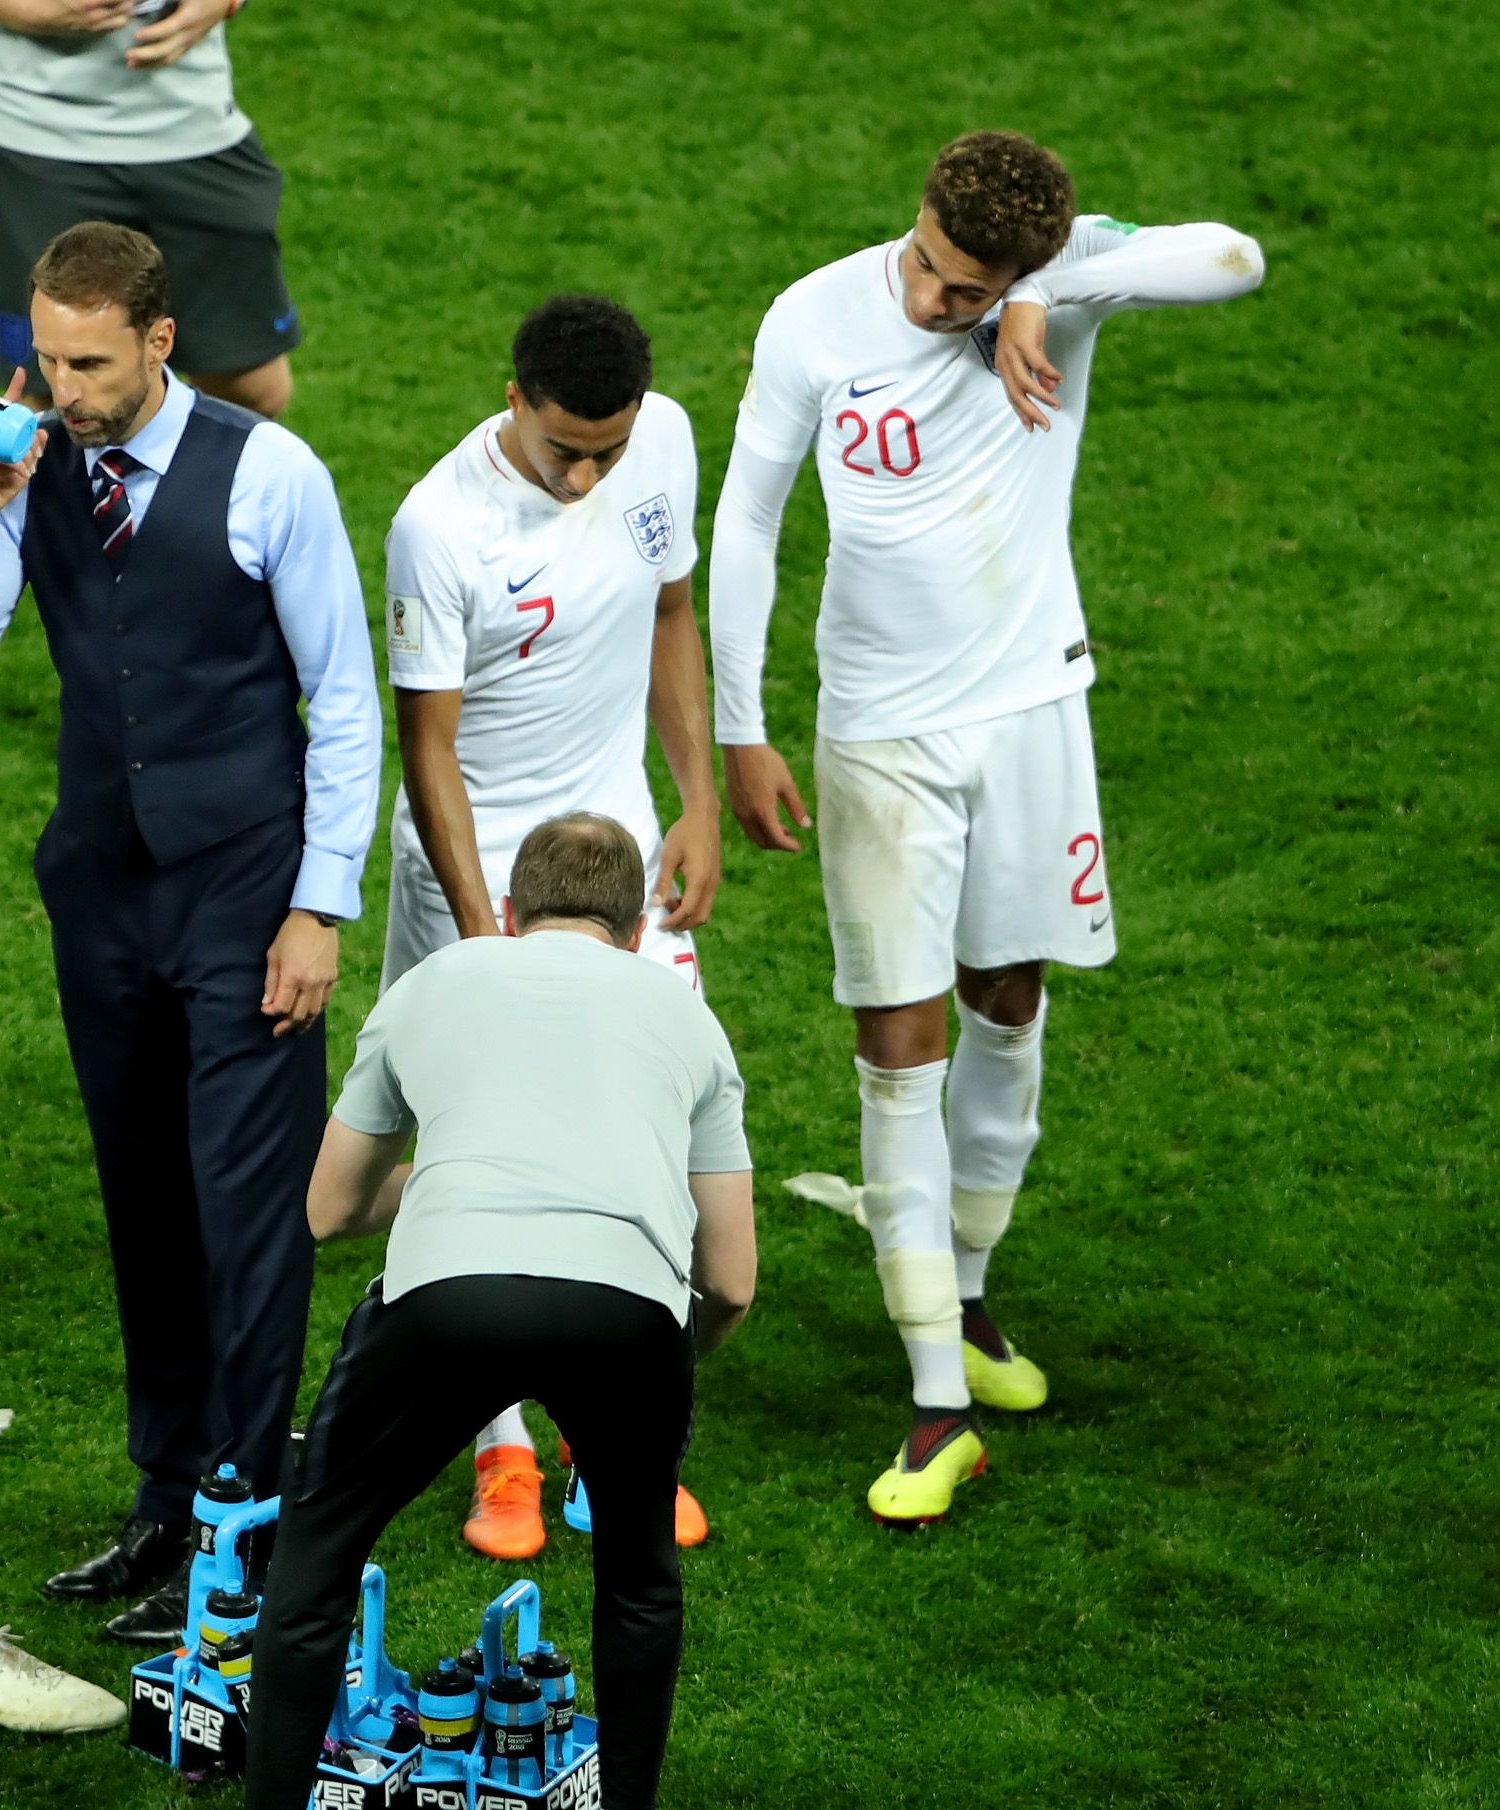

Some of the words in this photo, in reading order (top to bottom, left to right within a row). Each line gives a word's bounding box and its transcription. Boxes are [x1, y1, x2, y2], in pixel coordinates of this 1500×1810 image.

[836, 408, 921, 477] 20
[516, 595, 555, 659] 7
[134, 1679, 225, 1731] POWER
[169, 1714, 223, 1751] ADE
[547, 1753, 600, 1810] POWE
[575, 1782, 602, 1810] AD
